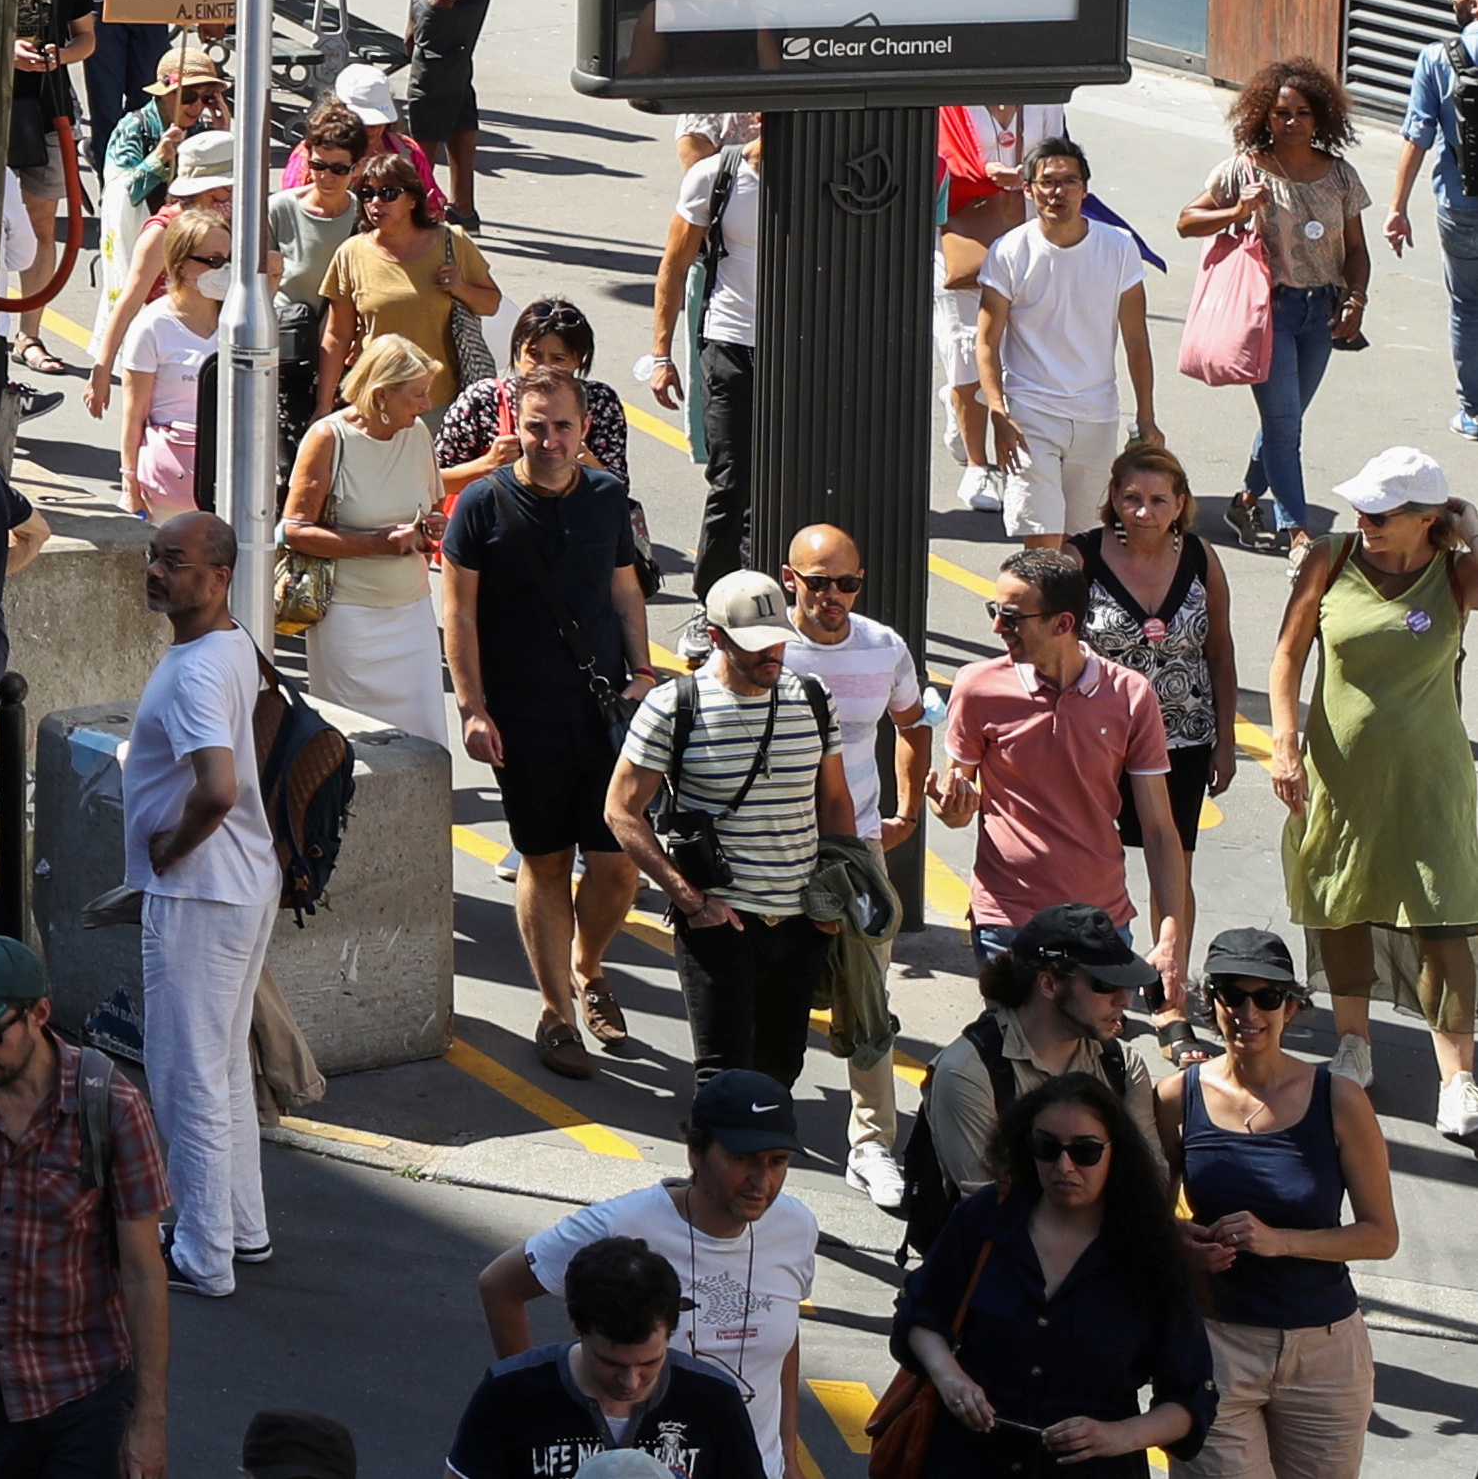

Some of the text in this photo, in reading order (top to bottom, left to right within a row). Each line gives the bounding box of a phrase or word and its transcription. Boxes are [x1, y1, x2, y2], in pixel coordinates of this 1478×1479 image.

[813, 35, 952, 58] Clear Channel
[532, 1444, 572, 1477] LIFE
